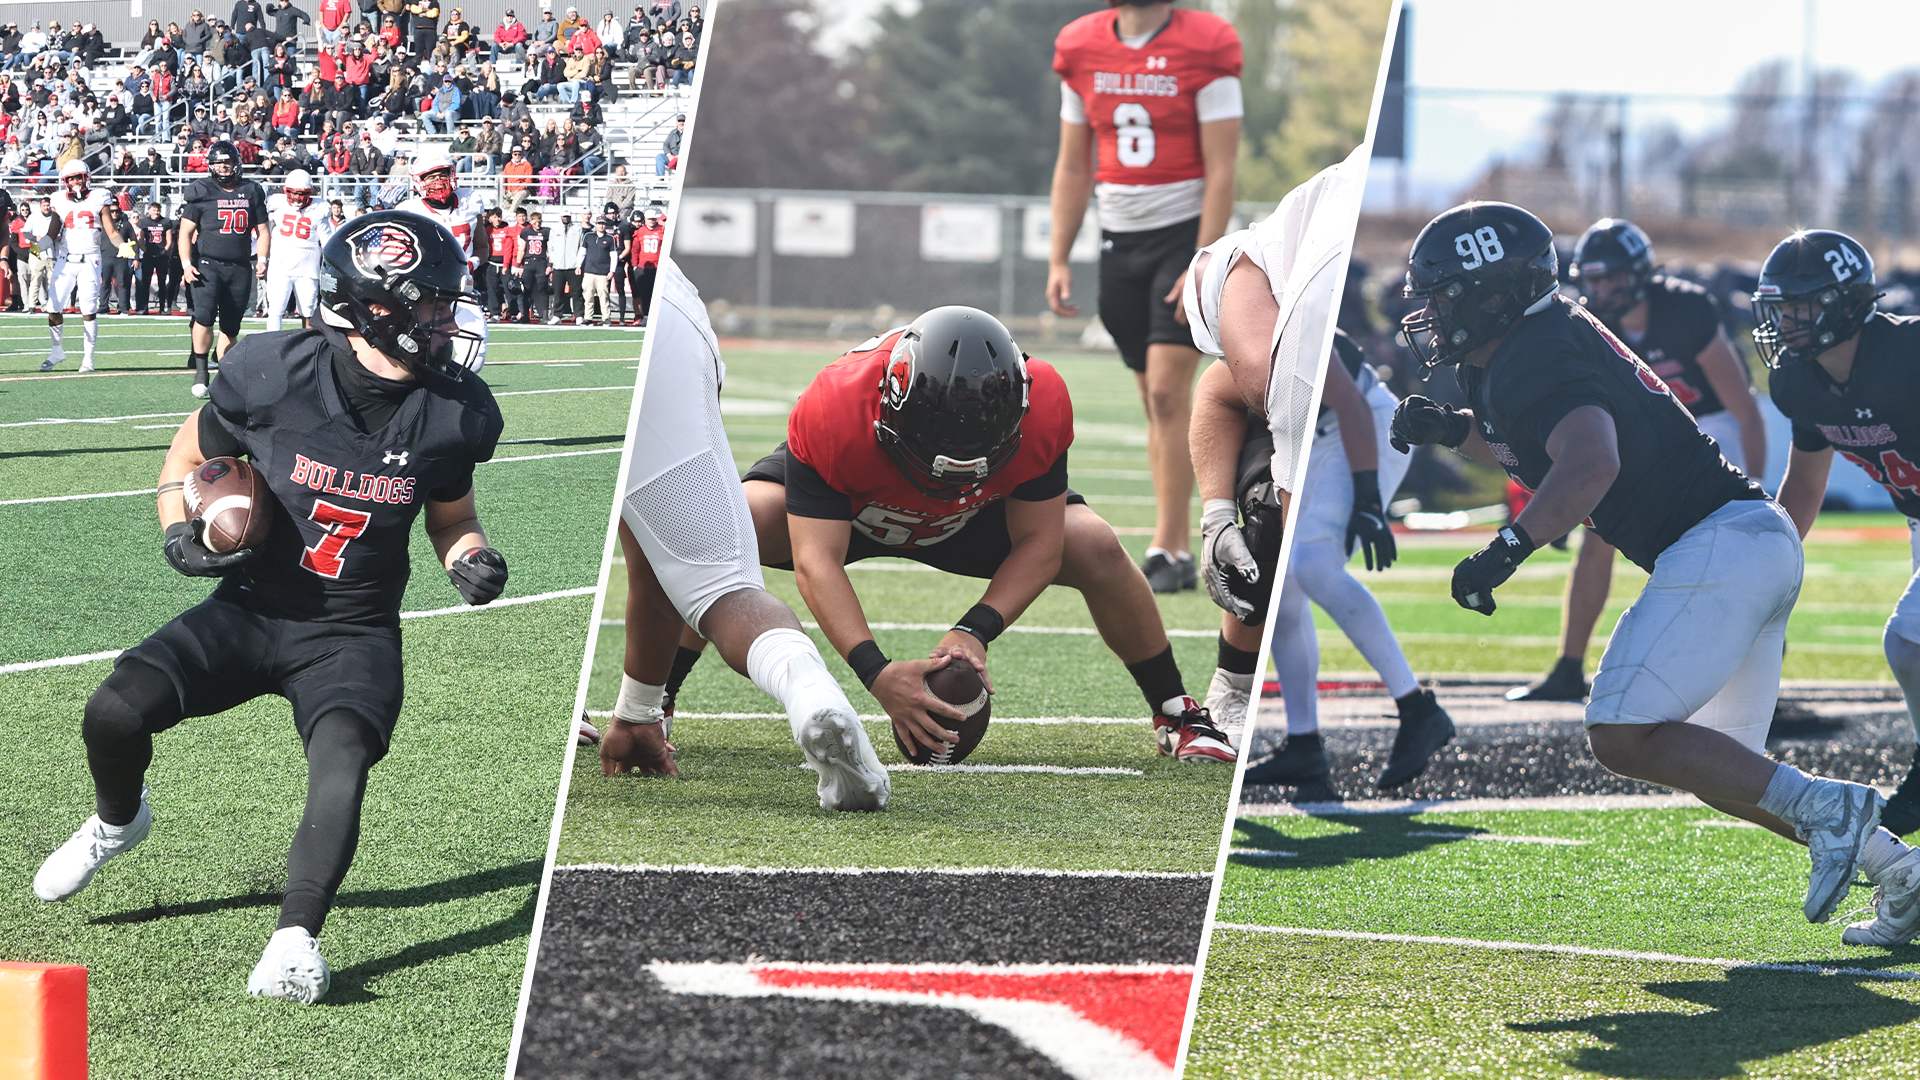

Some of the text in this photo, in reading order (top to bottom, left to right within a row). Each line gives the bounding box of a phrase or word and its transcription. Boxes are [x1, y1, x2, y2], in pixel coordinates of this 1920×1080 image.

[1093, 71, 1179, 98] BULLDOGS
[1113, 102, 1156, 168] 8
[218, 209, 249, 235] 70
[279, 213, 312, 240] 56
[493, 238, 503, 252] 5
[528, 240, 543, 255] 16
[643, 238, 659, 254] 60
[1454, 225, 1505, 271] 98
[1823, 242, 1864, 283] 24
[289, 453, 416, 506] BULLDOGS
[299, 499, 372, 580] 7
[851, 505, 980, 547] 53
